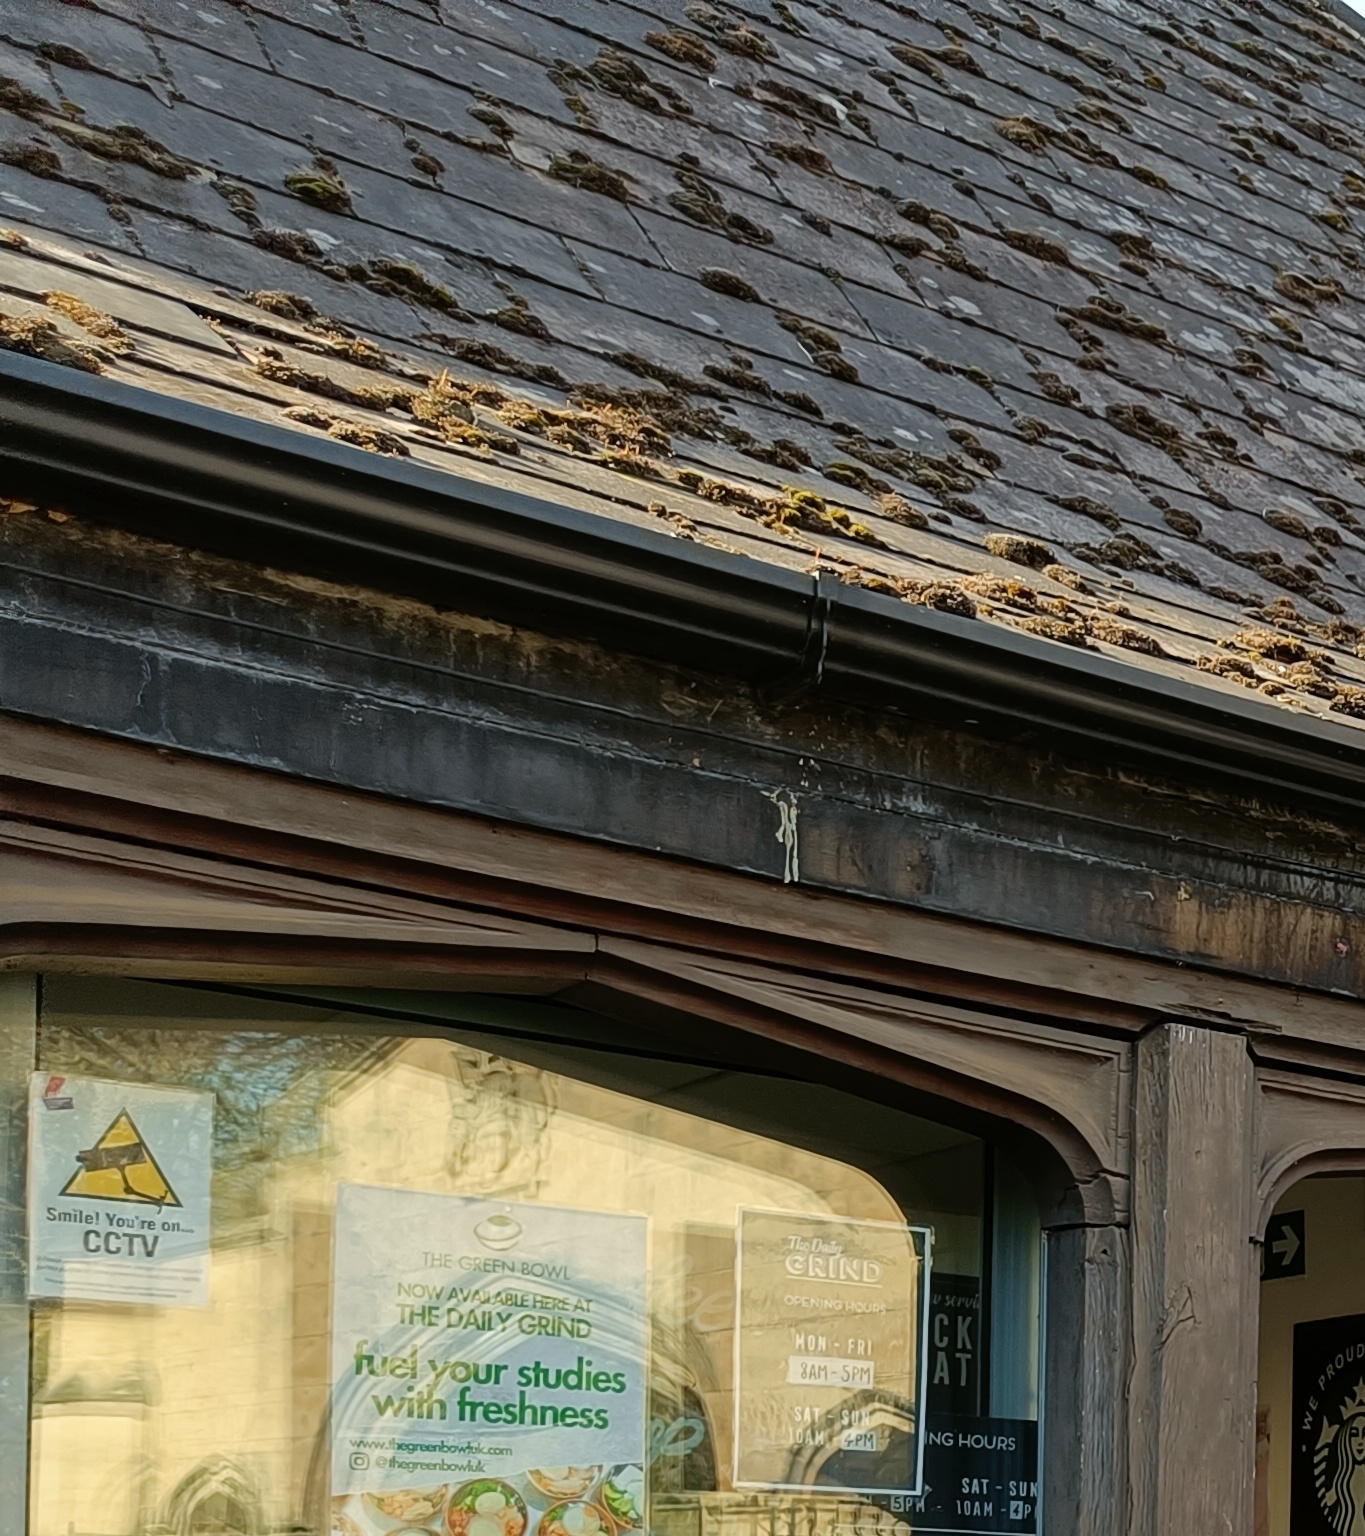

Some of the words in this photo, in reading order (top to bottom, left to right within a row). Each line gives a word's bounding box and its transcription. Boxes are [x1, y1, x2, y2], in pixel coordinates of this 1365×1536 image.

[46, 1207, 100, 1225] Smile!
[105, 1212, 156, 1231] You're
[83, 1230, 160, 1257] CCTV
[787, 1235, 810, 1251] The
[811, 1238, 843, 1259] Daily
[423, 1252, 452, 1269] THE
[458, 1256, 515, 1274] GREEN
[521, 1262, 571, 1280] BOWL
[785, 1252, 883, 1283] GRIND
[397, 1283, 444, 1301] NOW
[449, 1286, 529, 1308] AVAILABLE
[533, 1295, 569, 1311] HERE
[572, 1299, 593, 1313] AT
[784, 1294, 843, 1311] OPENING
[845, 1301, 887, 1315] HOURS
[397, 1303, 440, 1327] THE
[446, 1308, 512, 1332] DAILY
[518, 1313, 592, 1339] GRIND
[795, 1333, 826, 1352] MON
[847, 1338, 871, 1356] FRI
[354, 1340, 418, 1379] fuel
[428, 1359, 508, 1393] your
[517, 1356, 627, 1394] studies
[371, 1385, 447, 1420] with
[457, 1387, 609, 1429] freshness
[795, 1406, 820, 1423] SAT
[841, 1410, 869, 1427] SUN
[1302, 1396, 1319, 1430] WE
[349, 1438, 513, 1456] www.thegreenbowluk.com
[788, 1428, 824, 1446] 10AM
[844, 1433, 874, 1449] 4PM
[958, 1433, 1016, 1451] HOURS
[375, 1456, 486, 1473] @thegreenbowluk
[962, 1478, 989, 1494] SAT
[956, 1500, 993, 1516] 10AM
[1011, 1501, 1037, 1519] 4P
